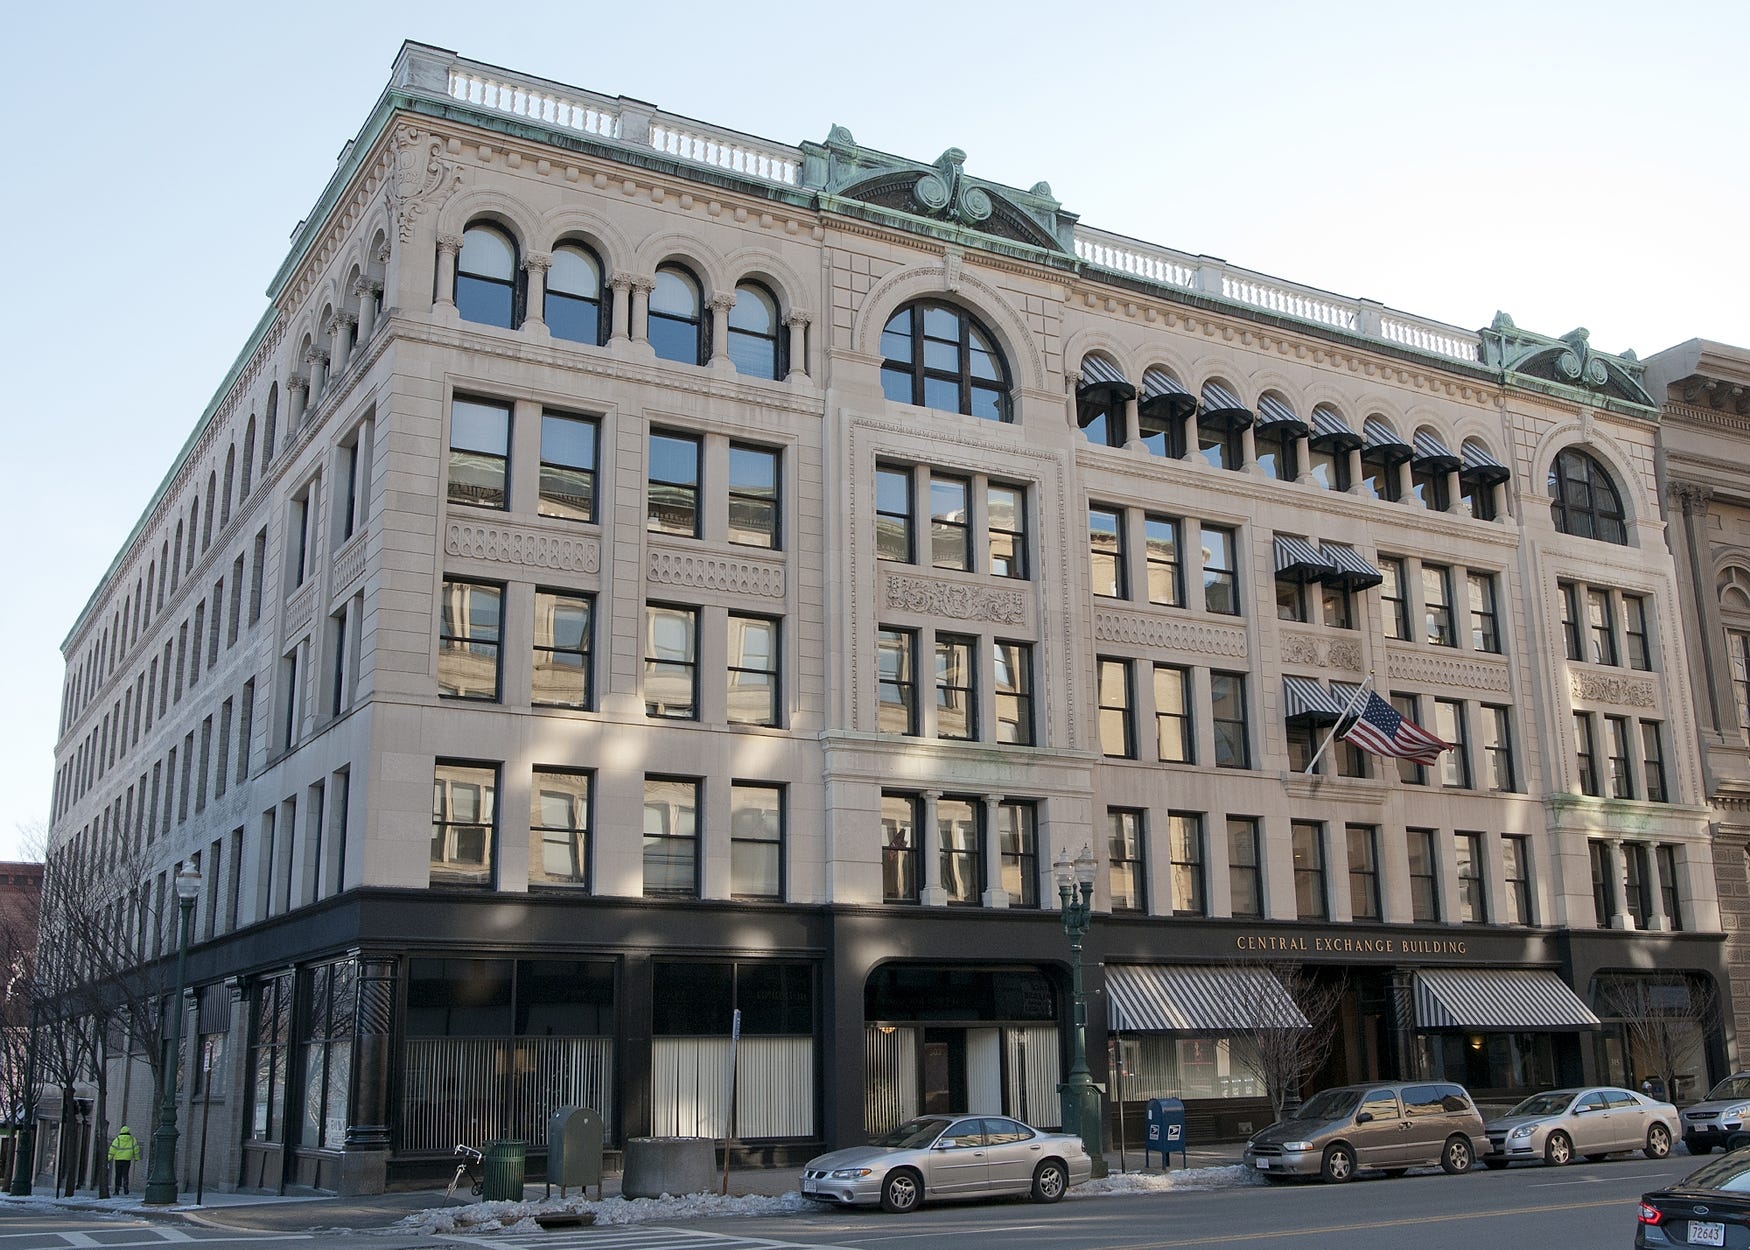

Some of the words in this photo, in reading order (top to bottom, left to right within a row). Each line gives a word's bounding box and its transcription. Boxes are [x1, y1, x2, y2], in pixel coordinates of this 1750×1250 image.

[1236, 936, 1308, 950] CENTRAL
[1315, 938, 1393, 953] EXCHANGE
[1402, 941, 1467, 954] BUILDING
[1692, 1226, 1719, 1240] 72643
